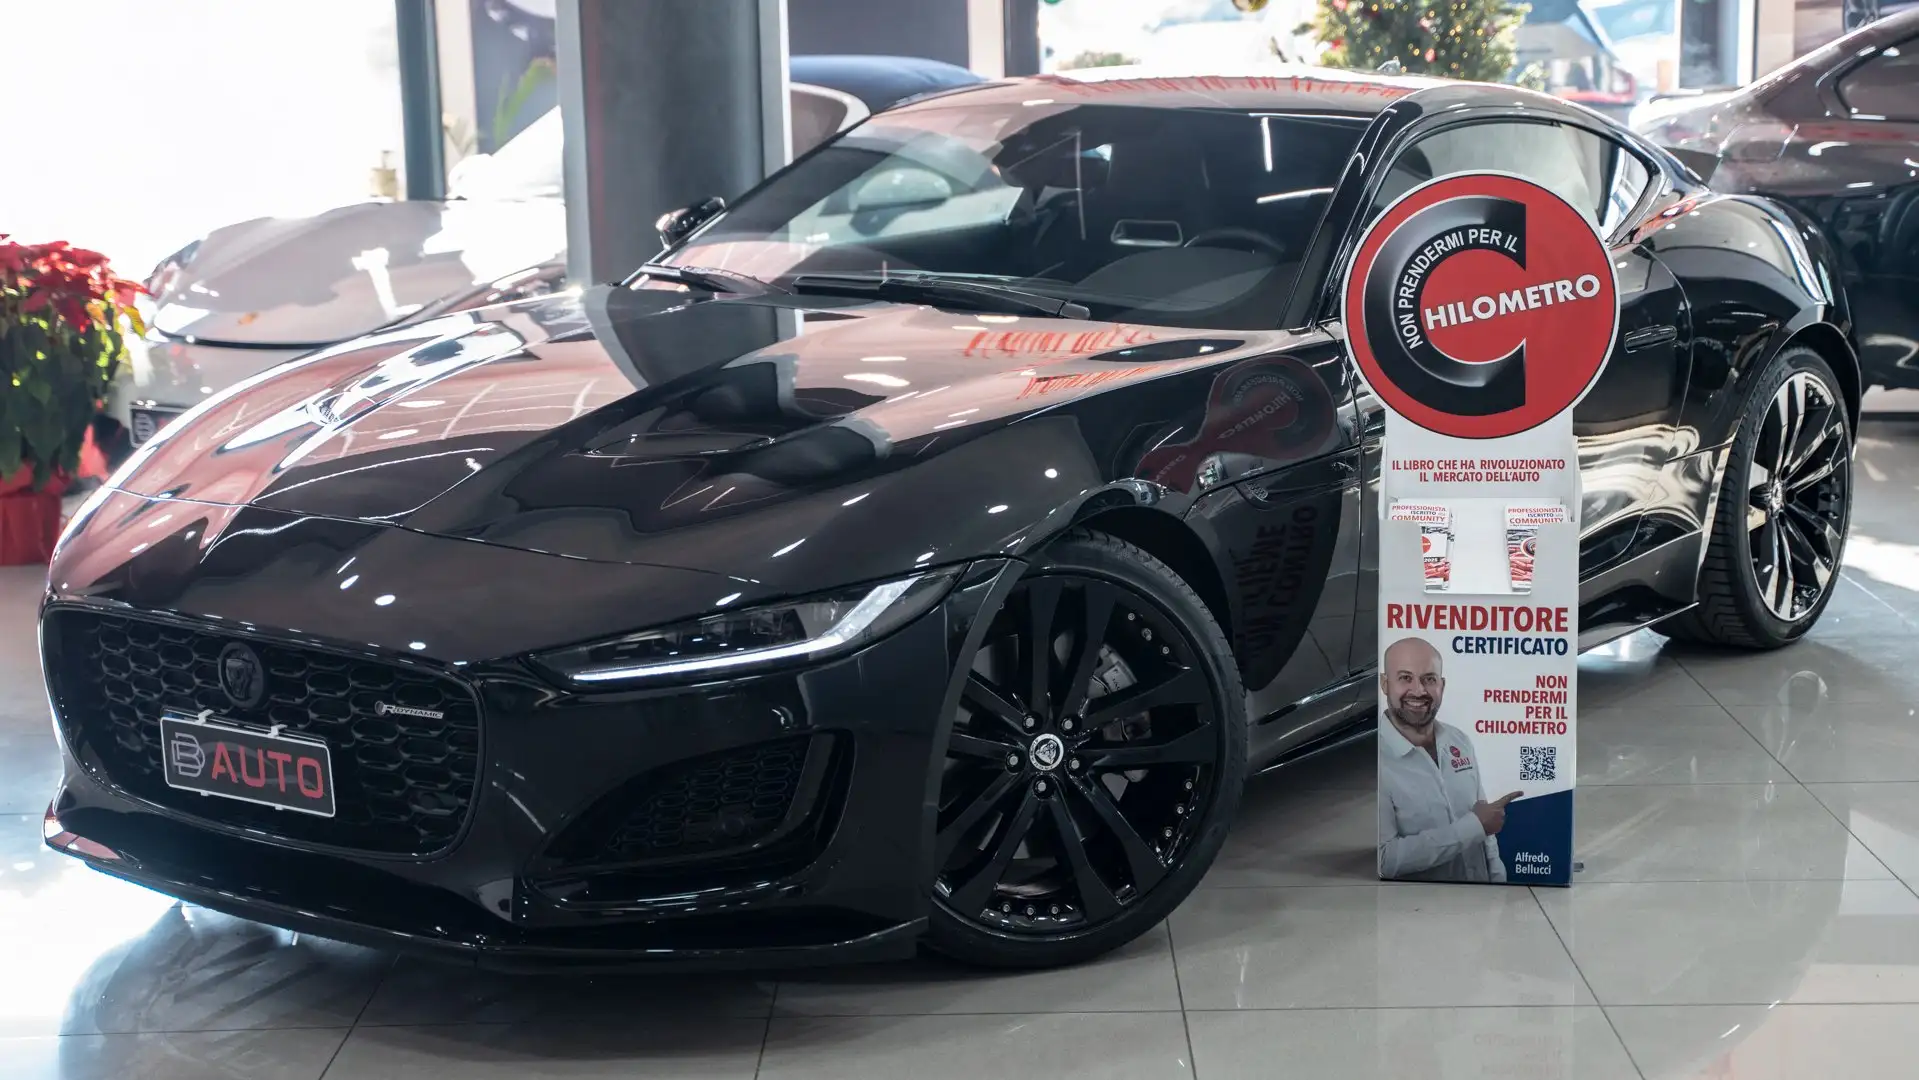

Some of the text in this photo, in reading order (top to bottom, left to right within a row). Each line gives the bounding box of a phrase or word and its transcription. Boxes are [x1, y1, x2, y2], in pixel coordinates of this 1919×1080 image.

[1398, 228, 1518, 349] NON PRENDERMI PER IL
[1392, 459, 1566, 471] IL LIBRO CHE HA RIVOLUZIONATO
[1419, 472, 1540, 483] IL MERCATO DELL'AUTO
[1392, 505, 1447, 513] PROFESSIONISTA
[1392, 515, 1446, 523] COMMUNITY
[1509, 517, 1564, 525] COMMUNITY
[1387, 604, 1569, 633] RIVENDITORE
[1452, 636, 1569, 656] CERTIFICATO
[1535, 675, 1568, 689] NON
[1484, 690, 1568, 704] PRENDERMI
[1525, 706, 1568, 720] PER IL
[1475, 720, 1568, 735] CHILOMETRO
[211, 741, 324, 799] AUTO
[1515, 852, 1550, 863] Alfredo
[1515, 864, 1551, 875] Bellucci
